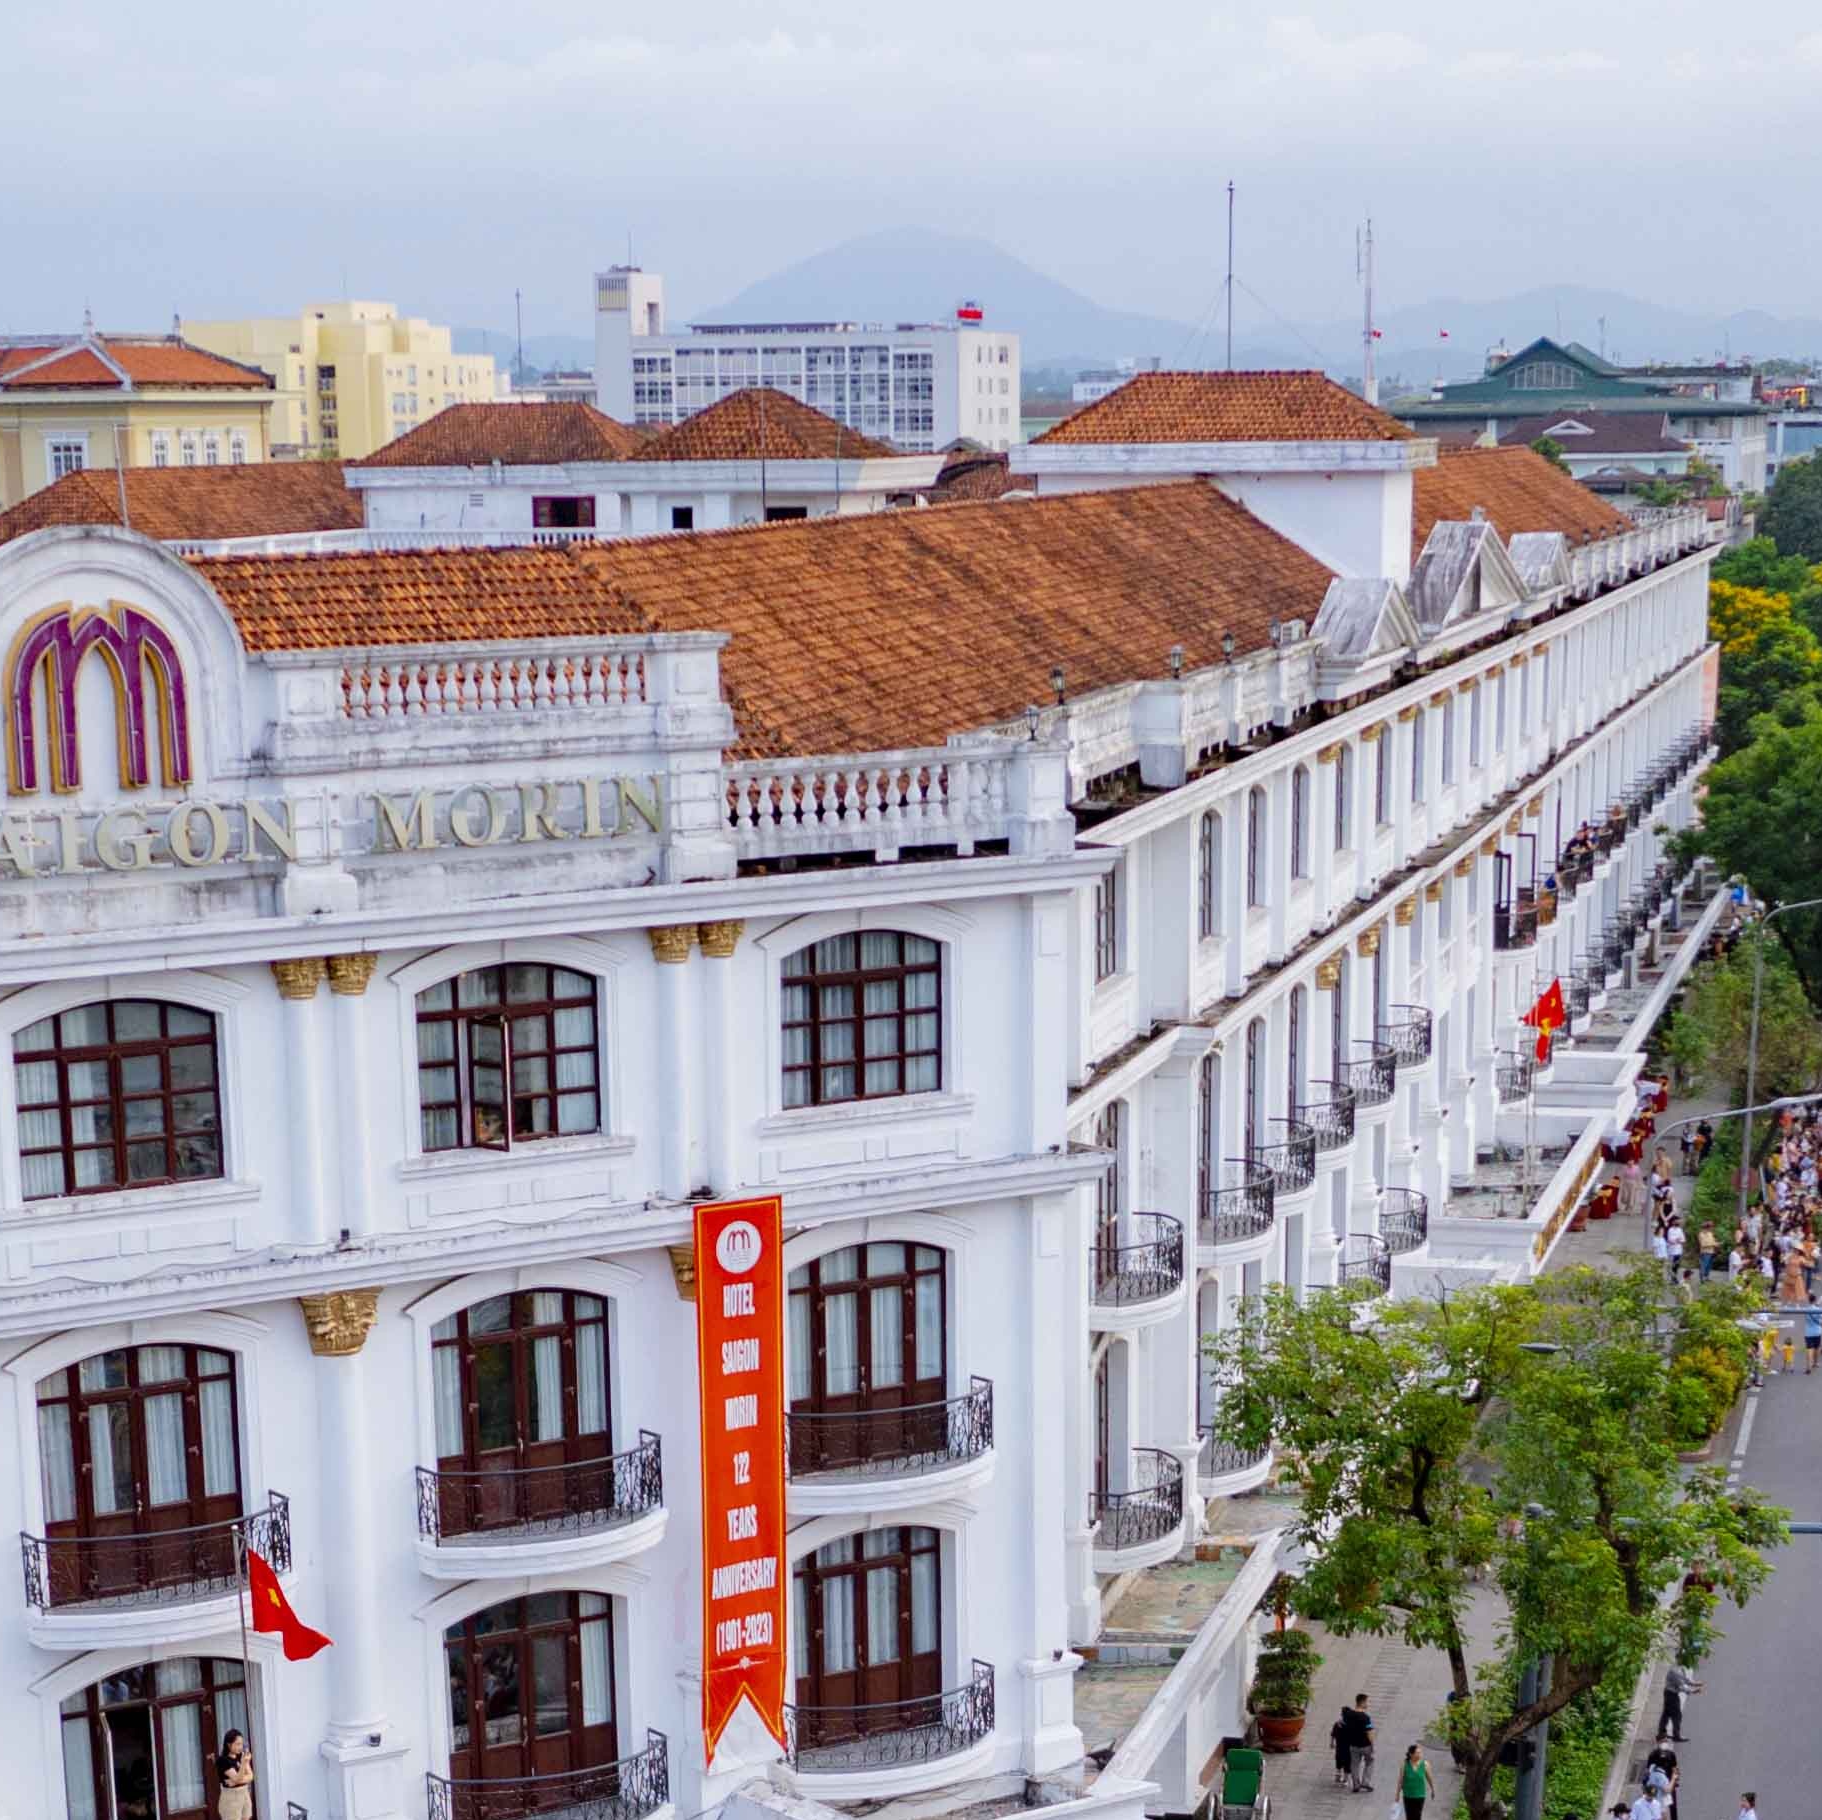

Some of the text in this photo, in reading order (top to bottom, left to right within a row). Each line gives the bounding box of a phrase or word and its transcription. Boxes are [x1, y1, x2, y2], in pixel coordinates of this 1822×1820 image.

[369, 772, 669, 855] MORIN
[722, 1282, 756, 1319] HOTEL
[721, 1338, 760, 1376] SAIGON
[725, 1395, 758, 1431] MORIN
[733, 1451, 750, 1484] 122
[727, 1505, 758, 1542] YEARS
[712, 1555, 777, 1601] ANNIVERSARY
[716, 1612, 773, 1656] (1901-2023)
